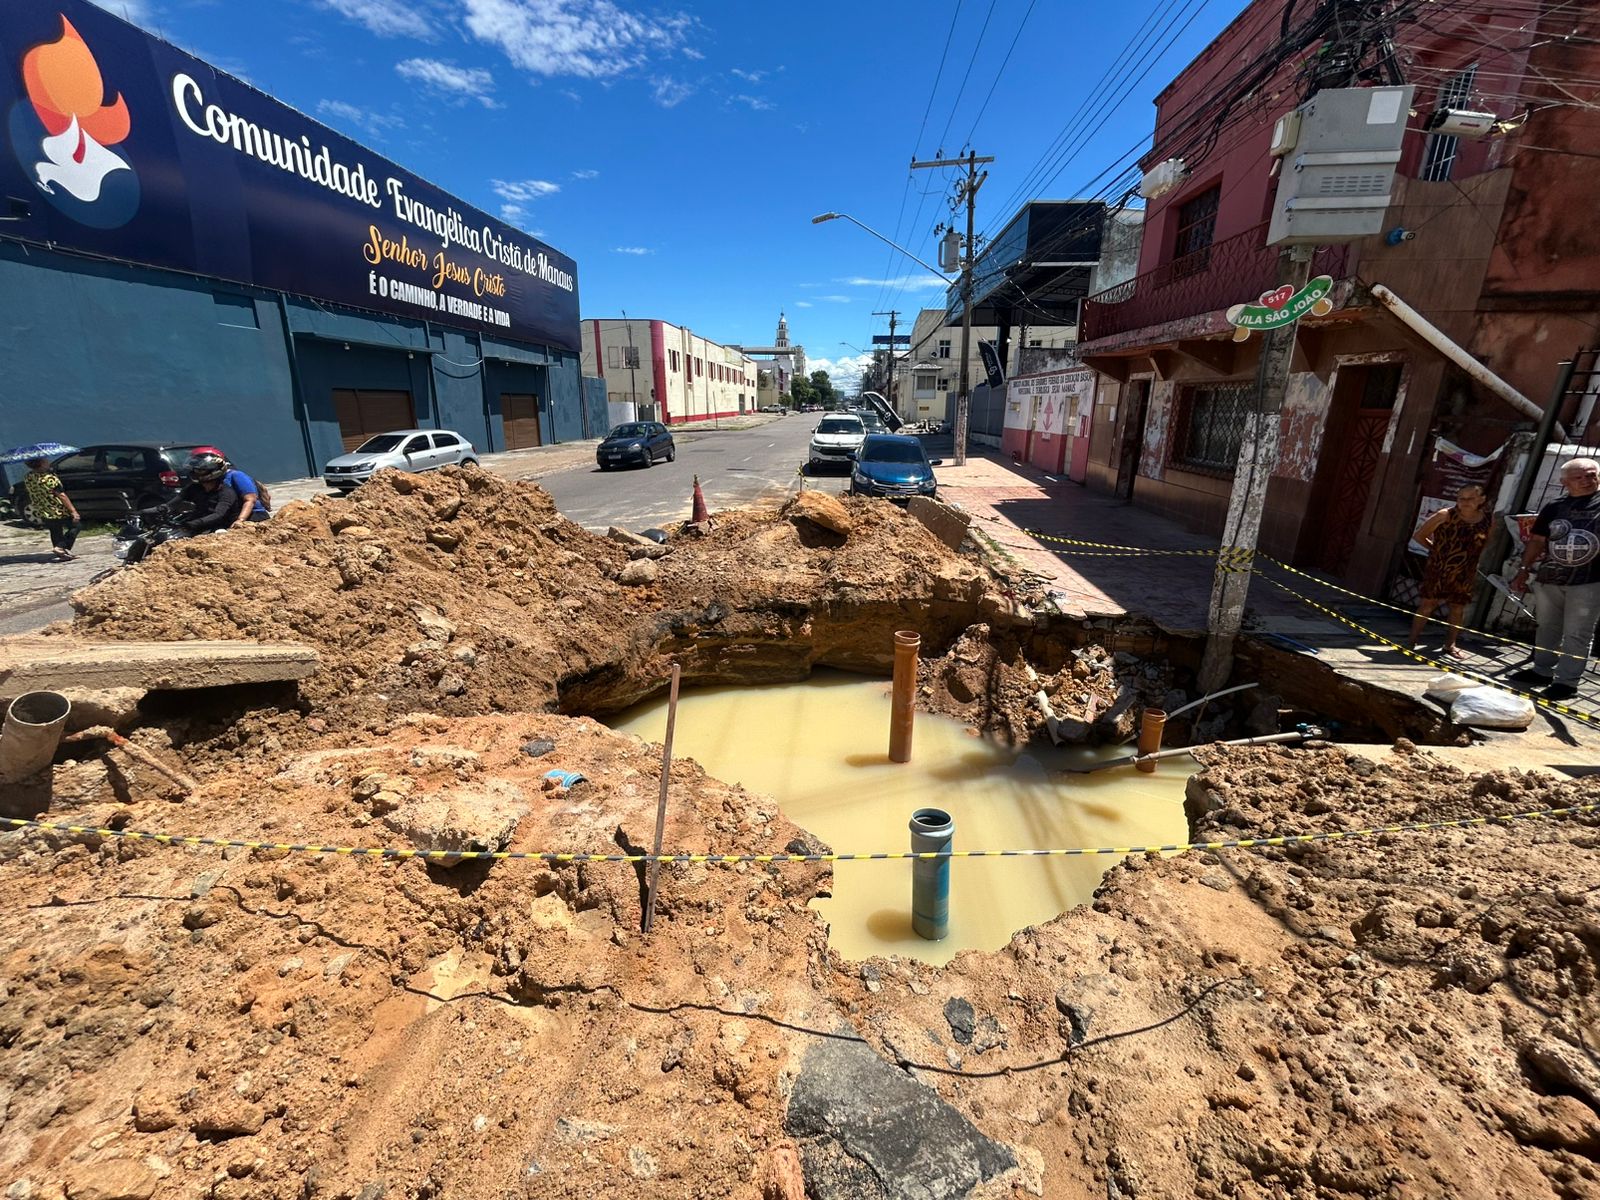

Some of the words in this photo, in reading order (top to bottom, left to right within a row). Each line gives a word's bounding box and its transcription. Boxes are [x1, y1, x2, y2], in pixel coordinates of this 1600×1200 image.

[172, 73, 381, 208] Comunidade
[386, 177, 482, 253] Evangélica
[483, 227, 523, 270] Cristã
[523, 248, 537, 276] de
[538, 252, 573, 292] Manaus
[363, 225, 428, 271] Senhor
[432, 252, 471, 289] Jesus
[473, 267, 506, 297] Cristo
[369, 270, 377, 295] É
[379, 276, 388, 297] O
[390, 279, 438, 311] CAMINHO,
[439, 293, 446, 312] A
[447, 295, 482, 320] VERDADE
[483, 305, 488, 322] E
[488, 307, 494, 323] A
[494, 309, 511, 328] VIDA
[1237, 315, 1263, 325] VILA
[1265, 309, 1290, 323] SÃO
[1293, 289, 1322, 313] JOÃO
[1267, 292, 1286, 304] 517
